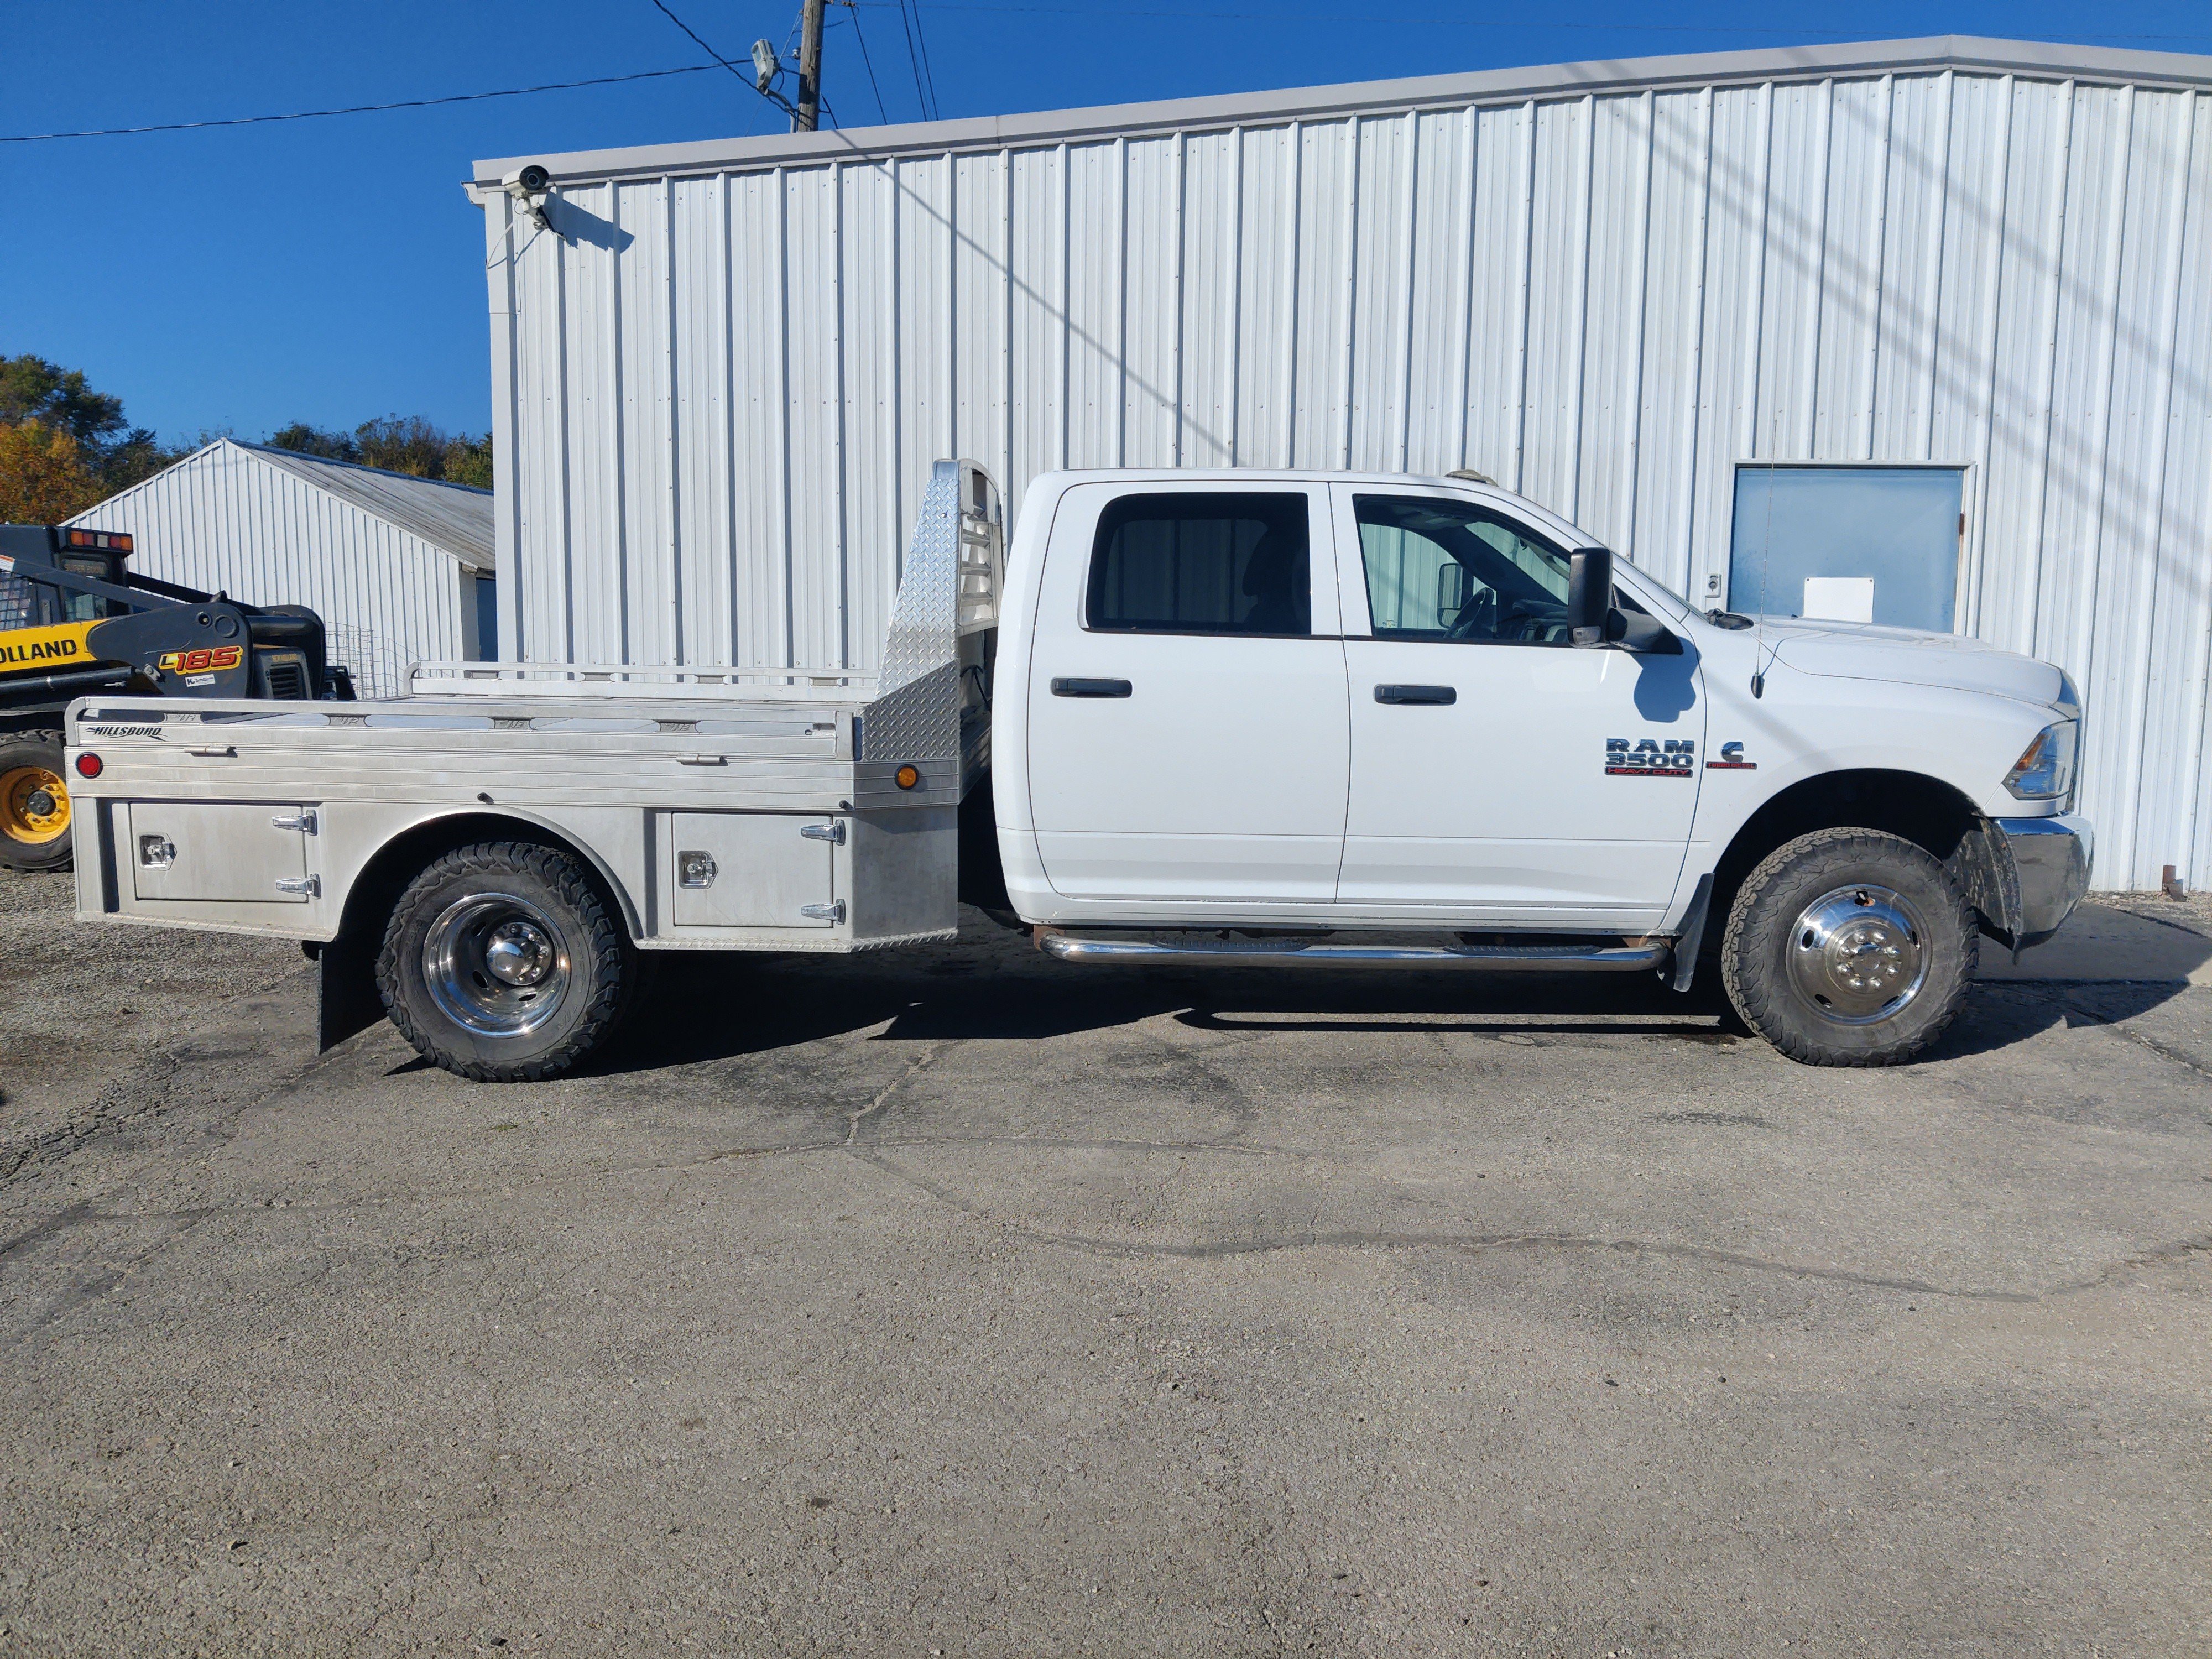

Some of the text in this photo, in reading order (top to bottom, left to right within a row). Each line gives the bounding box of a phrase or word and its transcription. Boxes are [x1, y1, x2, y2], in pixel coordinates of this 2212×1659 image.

[93, 726, 162, 735] HILLSBORO
[1606, 738, 1694, 754] RAM
[1605, 753, 1694, 768] 3500
